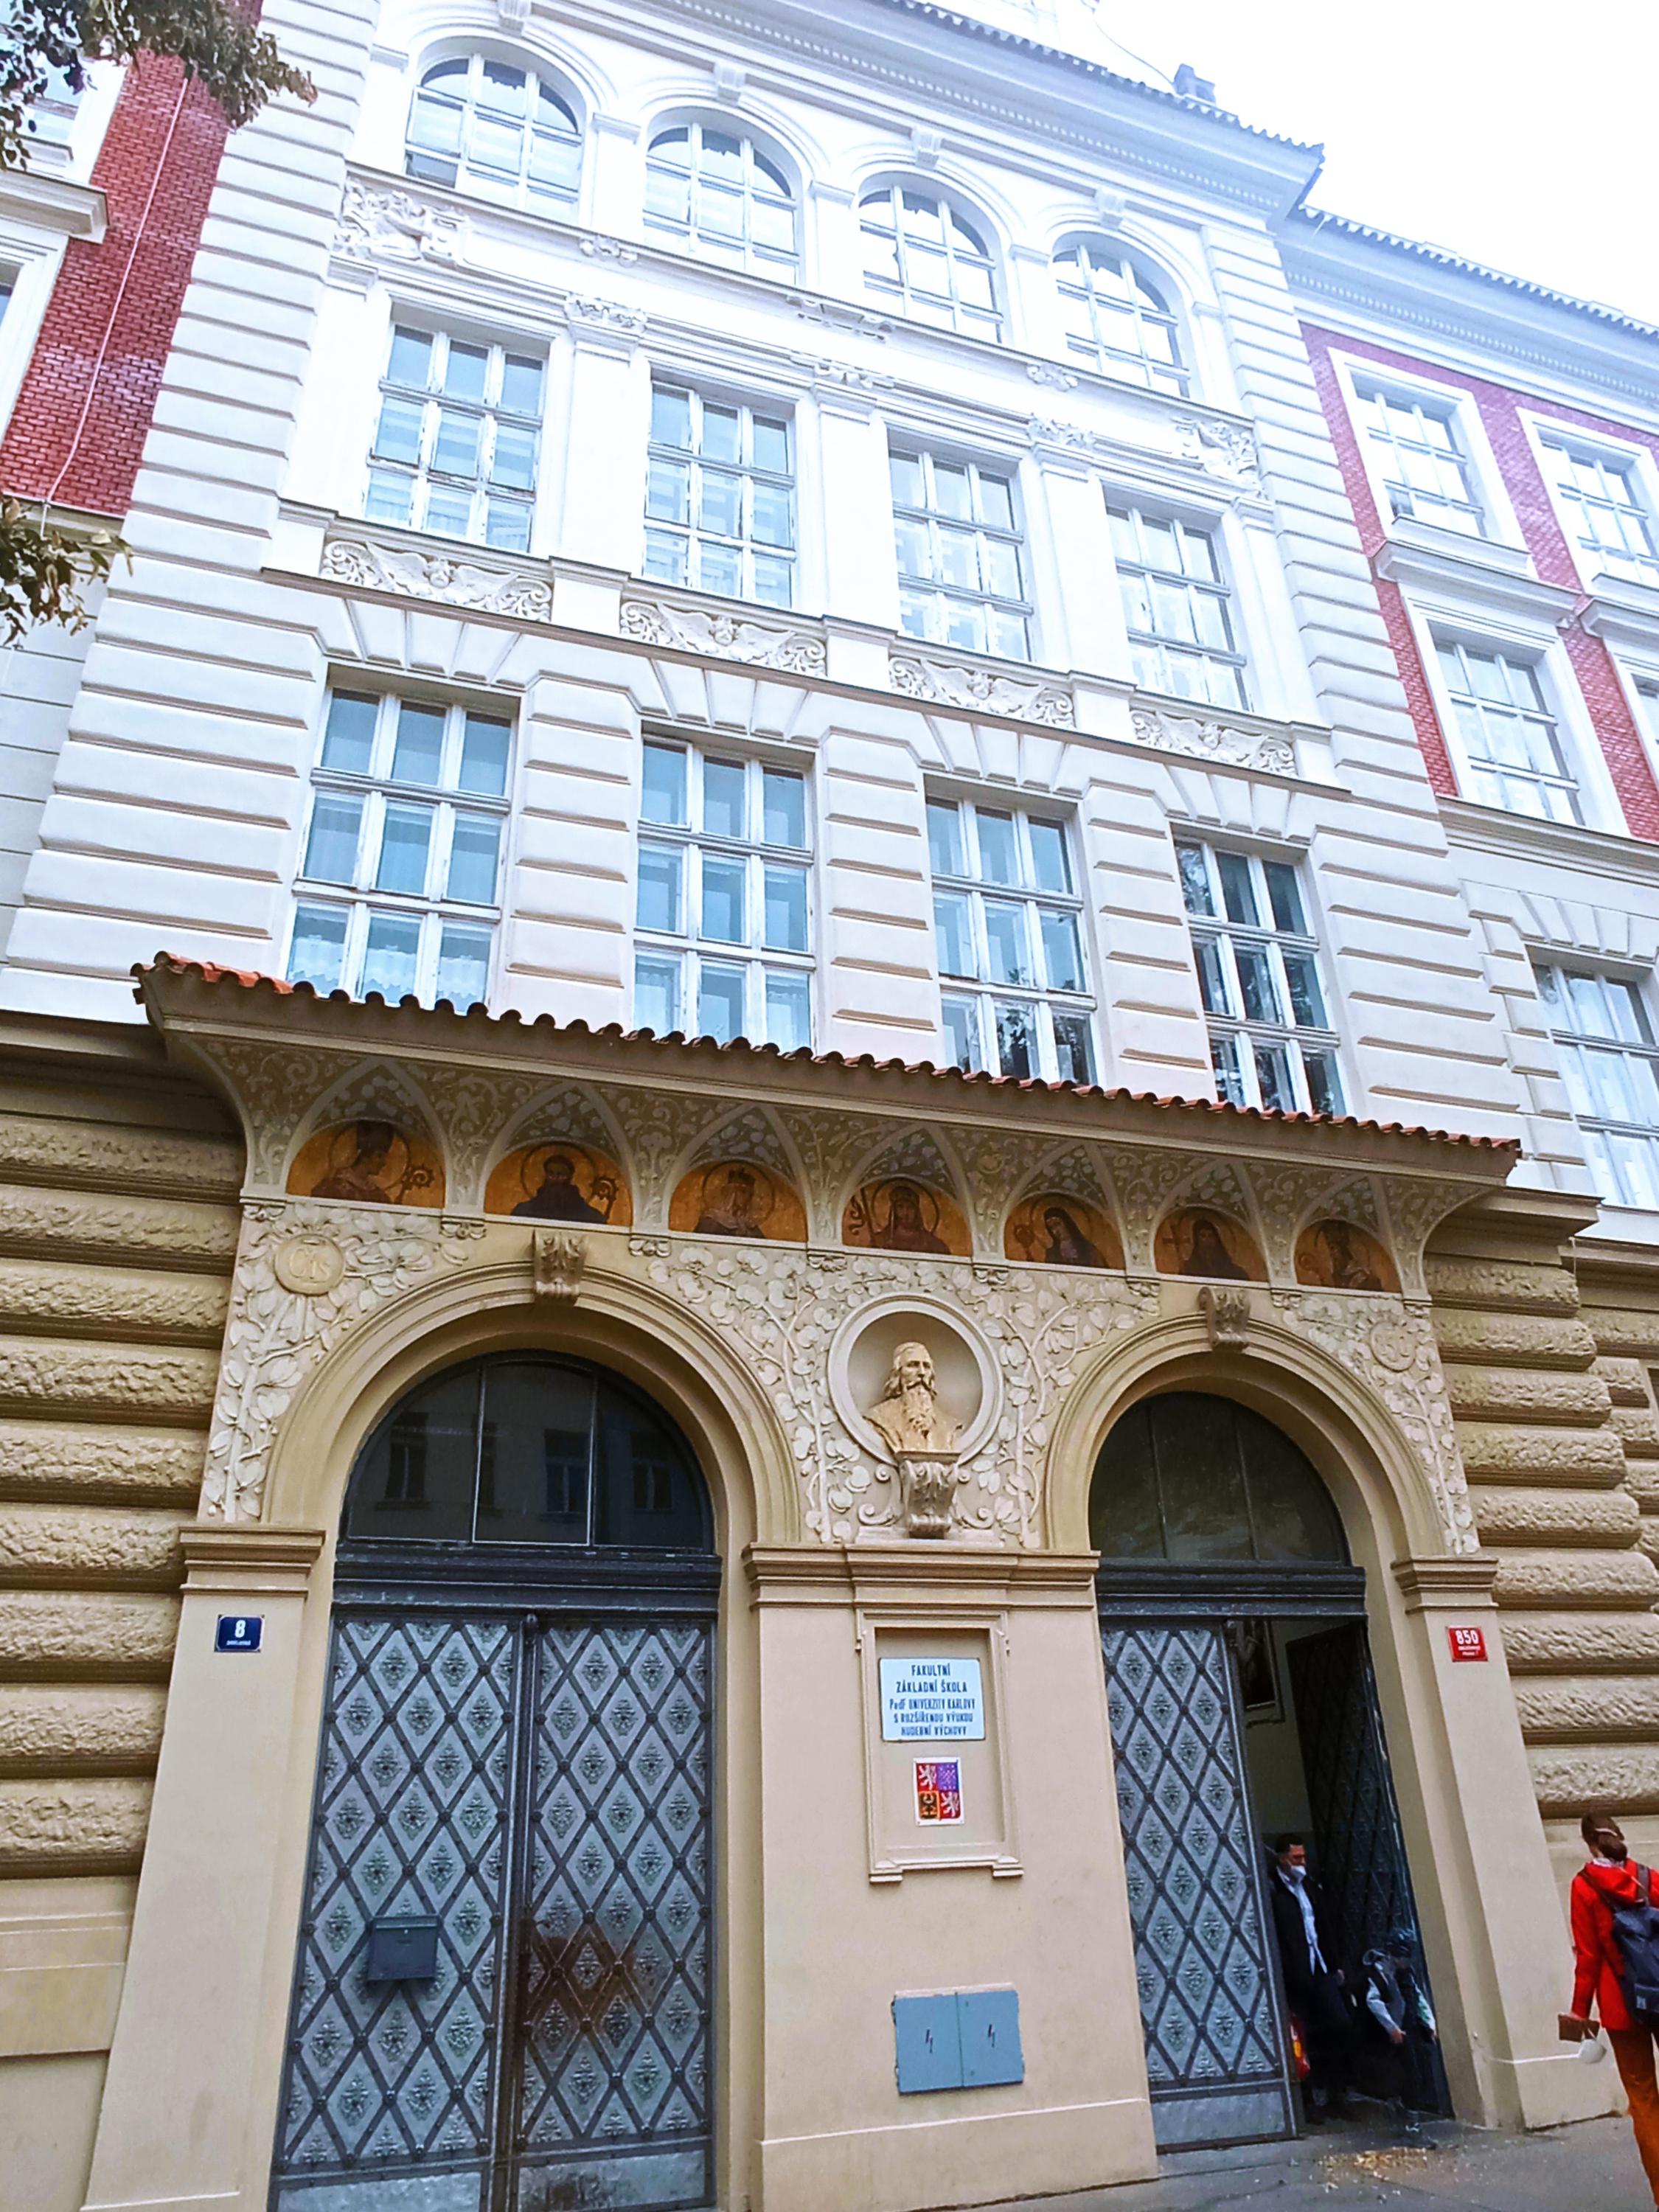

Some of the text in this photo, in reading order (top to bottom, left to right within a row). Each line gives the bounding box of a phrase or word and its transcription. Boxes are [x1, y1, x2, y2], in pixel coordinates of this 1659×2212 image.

[234, 1619, 246, 1638] 8
[1455, 1630, 1479, 1645] 850
[911, 1663, 951, 1677] FAKULTNÍ
[896, 1678, 967, 1693] ZÁKLADNÍ ŠKOLA
[908, 1698, 946, 1710] UNIVERZITY
[947, 1698, 975, 1710] KARLOVY
[894, 1713, 899, 1723] S
[901, 1724, 967, 1736] HUDEBNÍ VÝCHOVY
